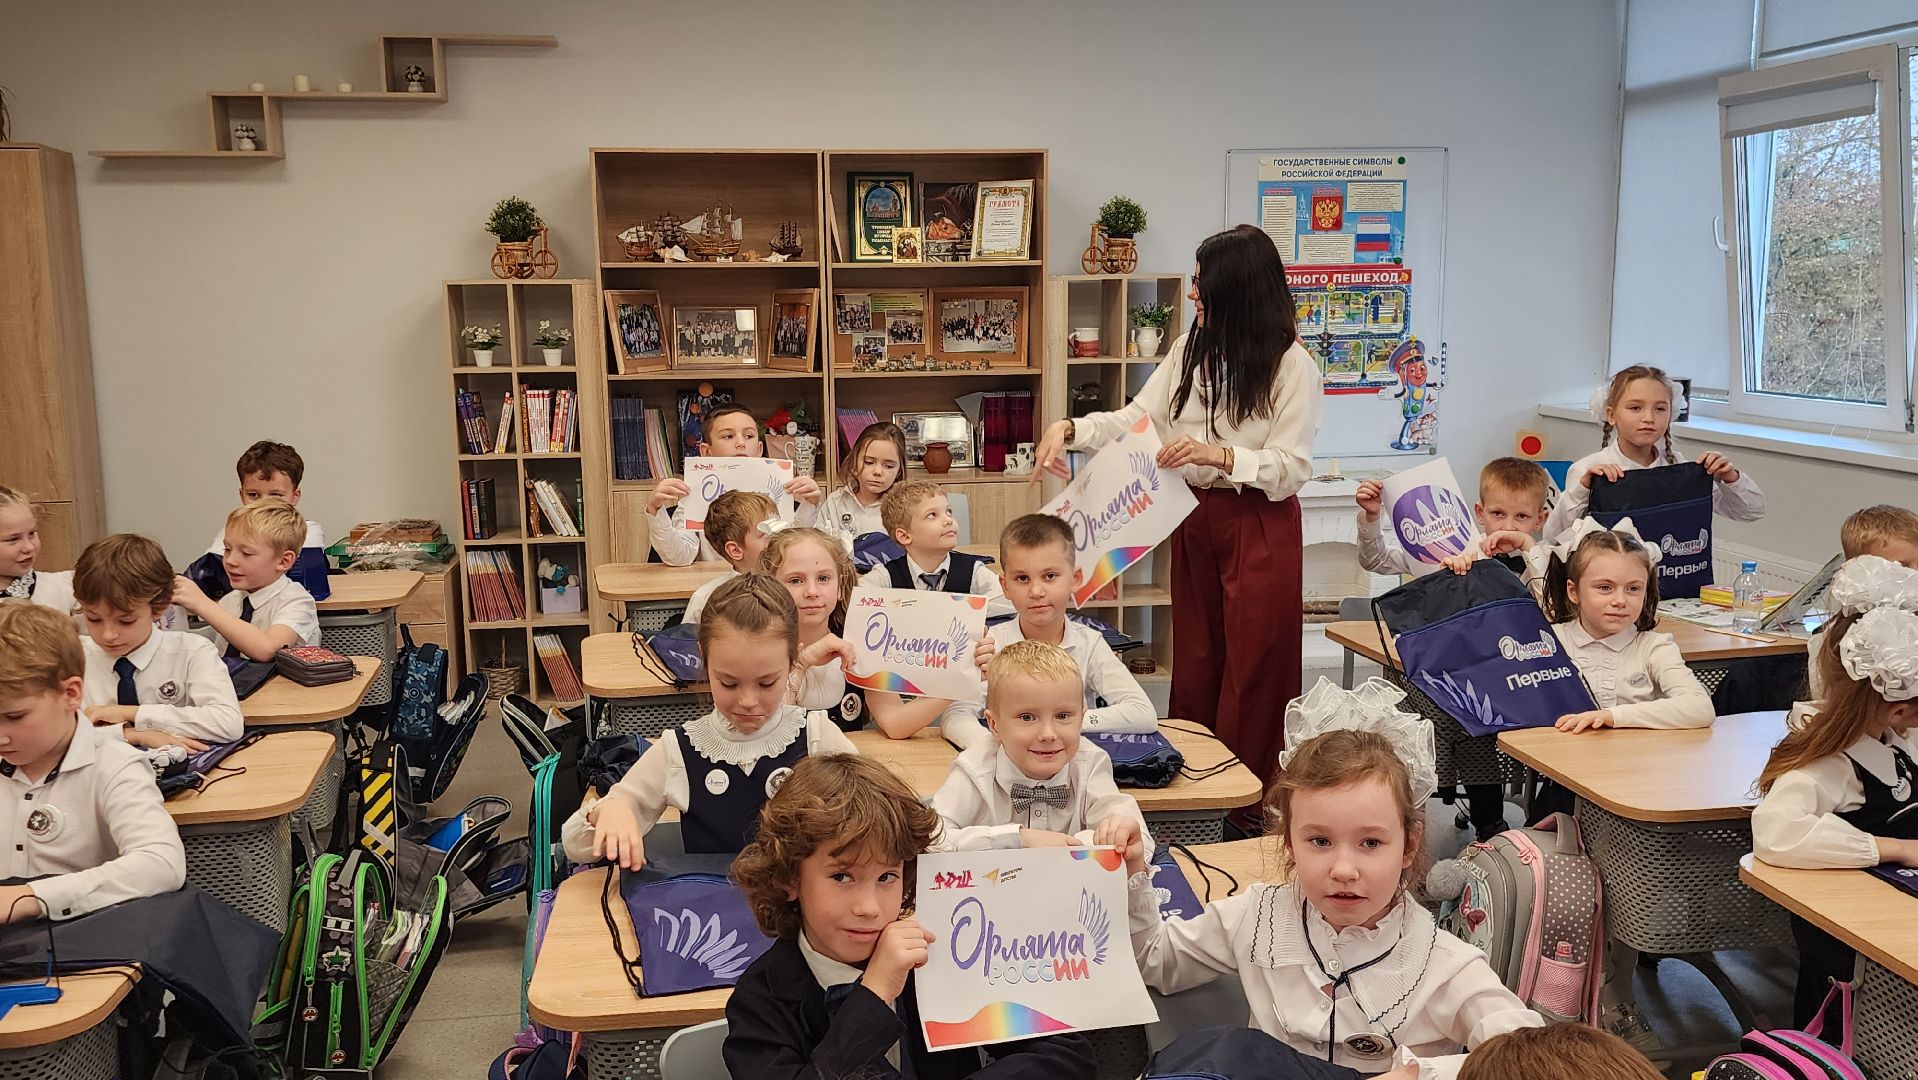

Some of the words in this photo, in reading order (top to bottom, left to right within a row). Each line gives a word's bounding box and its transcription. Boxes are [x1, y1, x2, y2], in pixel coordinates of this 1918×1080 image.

[1273, 157, 1351, 167] ГОСУДАРСТВЕННЫЕ
[1352, 157, 1393, 166] СИМВОЛЫ
[1281, 169, 1334, 178] РОССИЙСКОЙ
[1335, 169, 1383, 178] ФЕДЕРАЦИИ
[1069, 478, 1147, 551] Орлята
[1402, 517, 1454, 542] Орлята
[1657, 561, 1708, 579] Первые
[865, 611, 949, 657] Орлята
[1506, 666, 1572, 691] Первые
[951, 896, 1087, 977] Орлята
